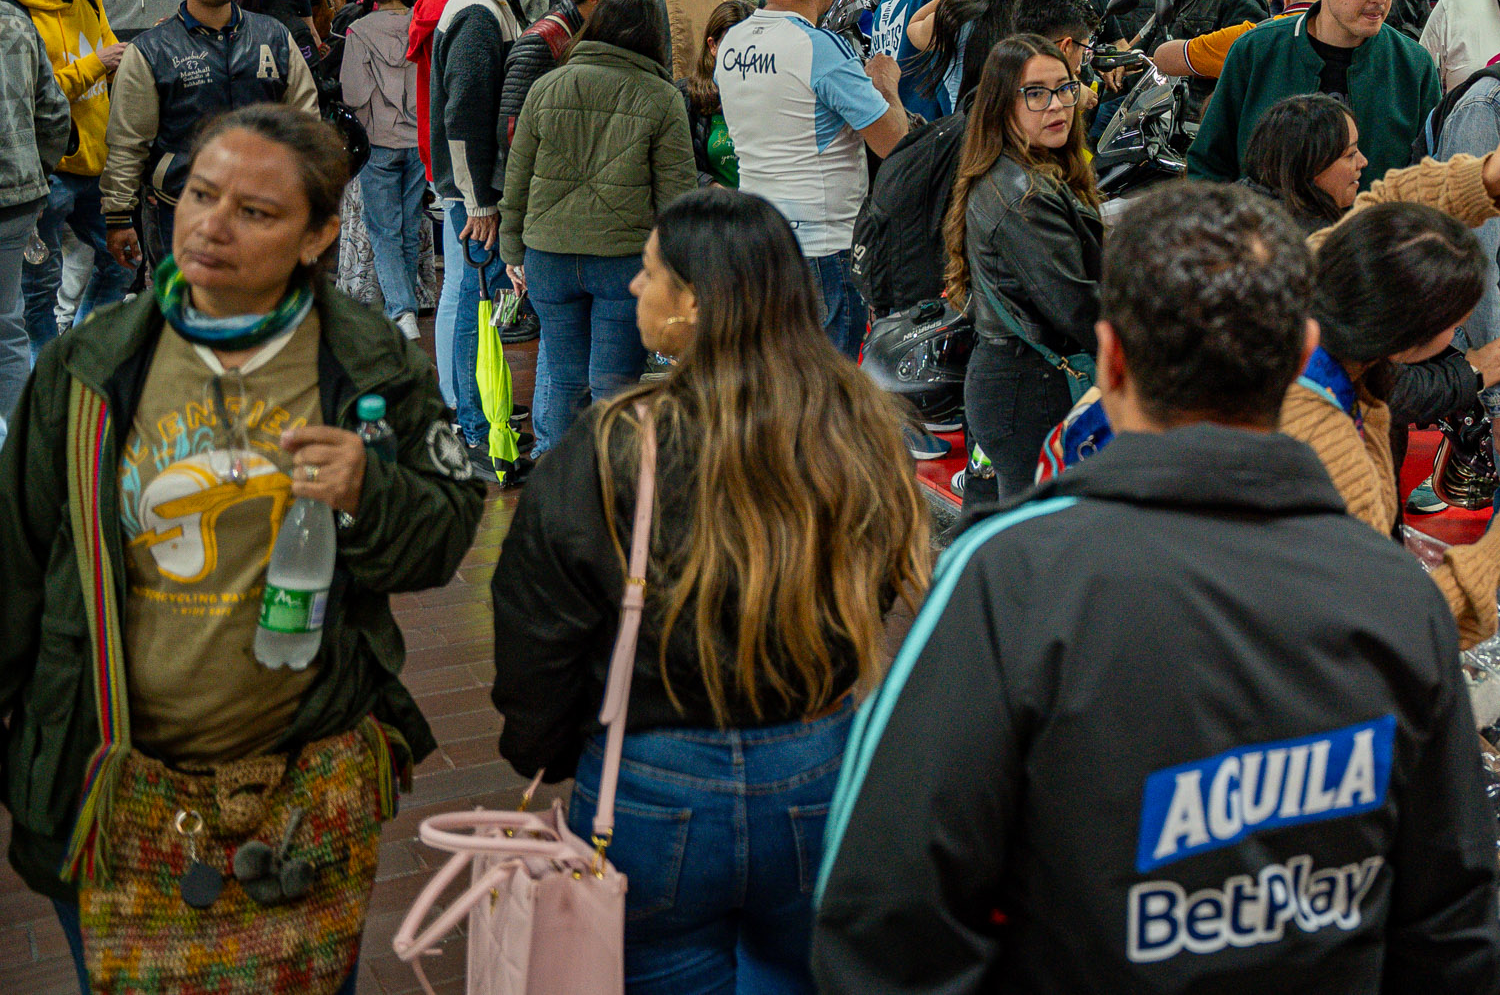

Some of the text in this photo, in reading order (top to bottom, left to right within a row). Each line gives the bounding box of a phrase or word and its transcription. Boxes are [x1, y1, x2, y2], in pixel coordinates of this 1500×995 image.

[256, 44, 280, 79] A
[1152, 728, 1377, 861] AGUILA
[1126, 853, 1386, 963] BetPlay
